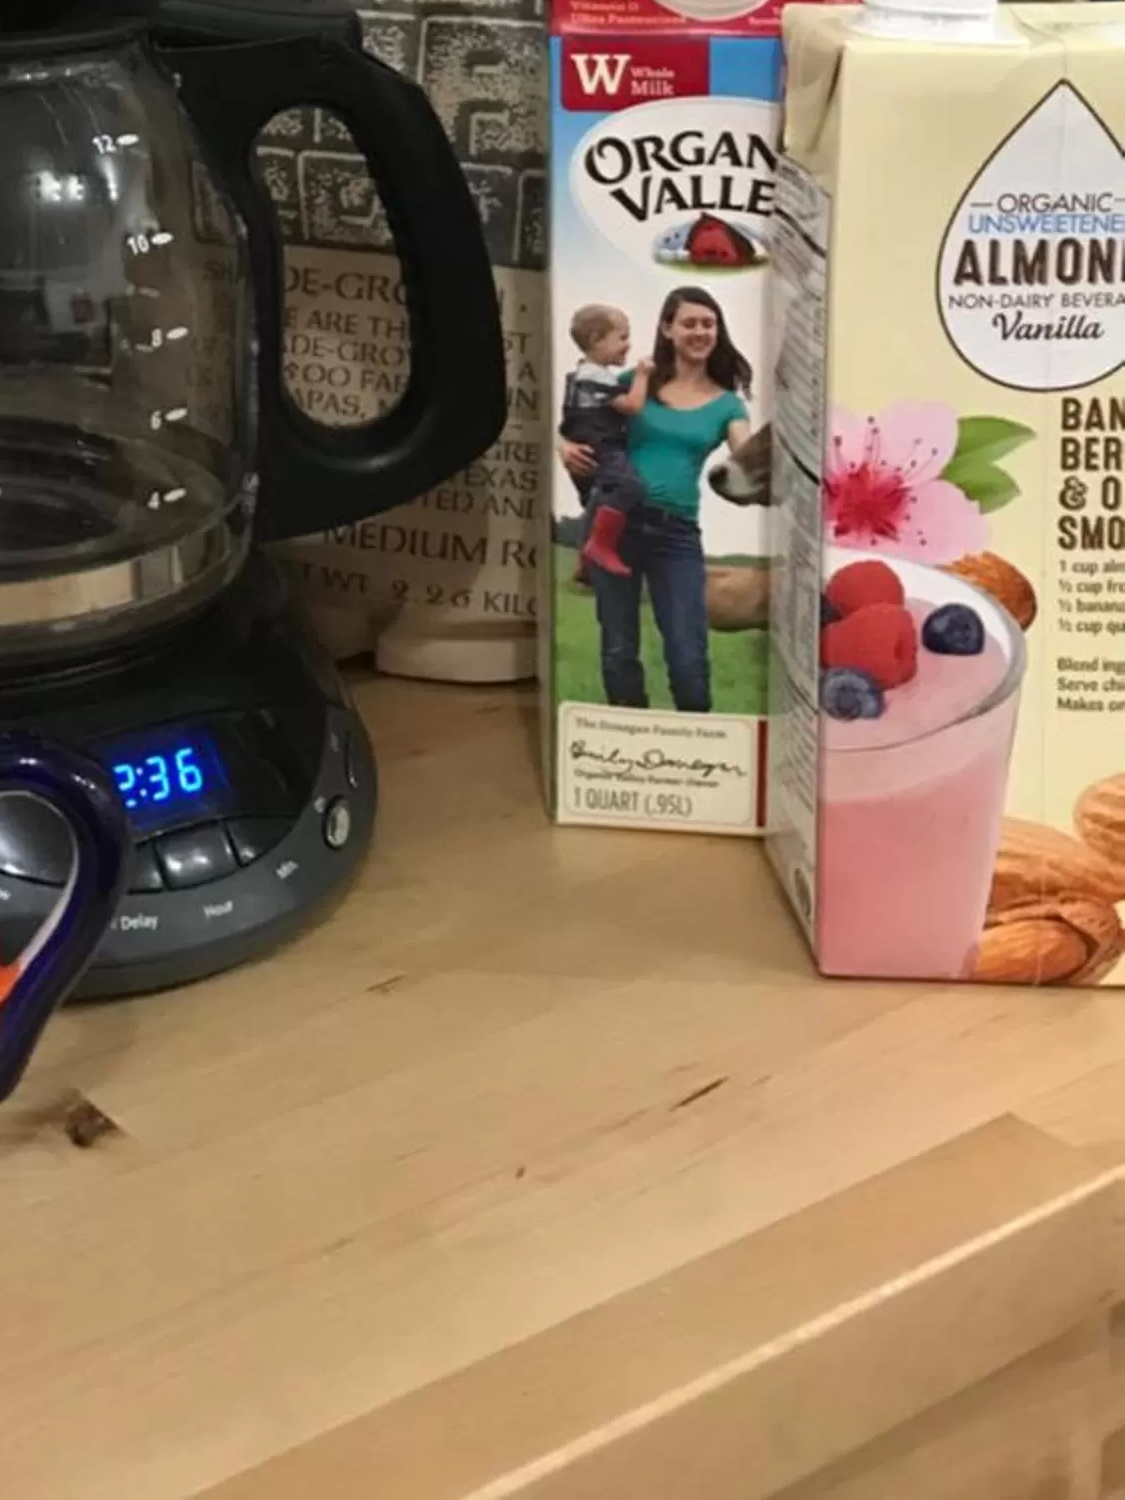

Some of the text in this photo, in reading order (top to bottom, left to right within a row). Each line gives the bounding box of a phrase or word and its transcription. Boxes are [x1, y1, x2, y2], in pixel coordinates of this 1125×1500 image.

[570, 53, 631, 96] W
[630, 80, 674, 96] Milk
[92, 134, 117, 154] 12
[609, 173, 777, 222] VALLE
[996, 192, 1114, 213] ORGANIC
[127, 234, 150, 255] 10
[948, 292, 1055, 310] NON-DAIRY
[306, 309, 361, 335] ARE
[991, 310, 1106, 341] Vanilla
[151, 328, 163, 347] 8
[284, 333, 405, 367] DE-GRO
[150, 410, 163, 430] 6
[1060, 397, 1125, 432] BAN
[1060, 435, 1123, 471] BER
[147, 490, 160, 510] 4
[1059, 475, 1088, 511] &
[325, 518, 487, 566] MEDIUM
[1057, 514, 1125, 550] SMO
[1071, 561, 1100, 578] cup
[1076, 581, 1104, 596] cup
[1075, 620, 1104, 637] cup
[1057, 656, 1100, 672] Blend
[1057, 676, 1100, 692] Serve
[1056, 697, 1104, 712] Makes
[113, 747, 204, 808] 2:36
[574, 786, 582, 809] 1
[585, 786, 640, 812] QUART
[120, 913, 159, 932] Delay
